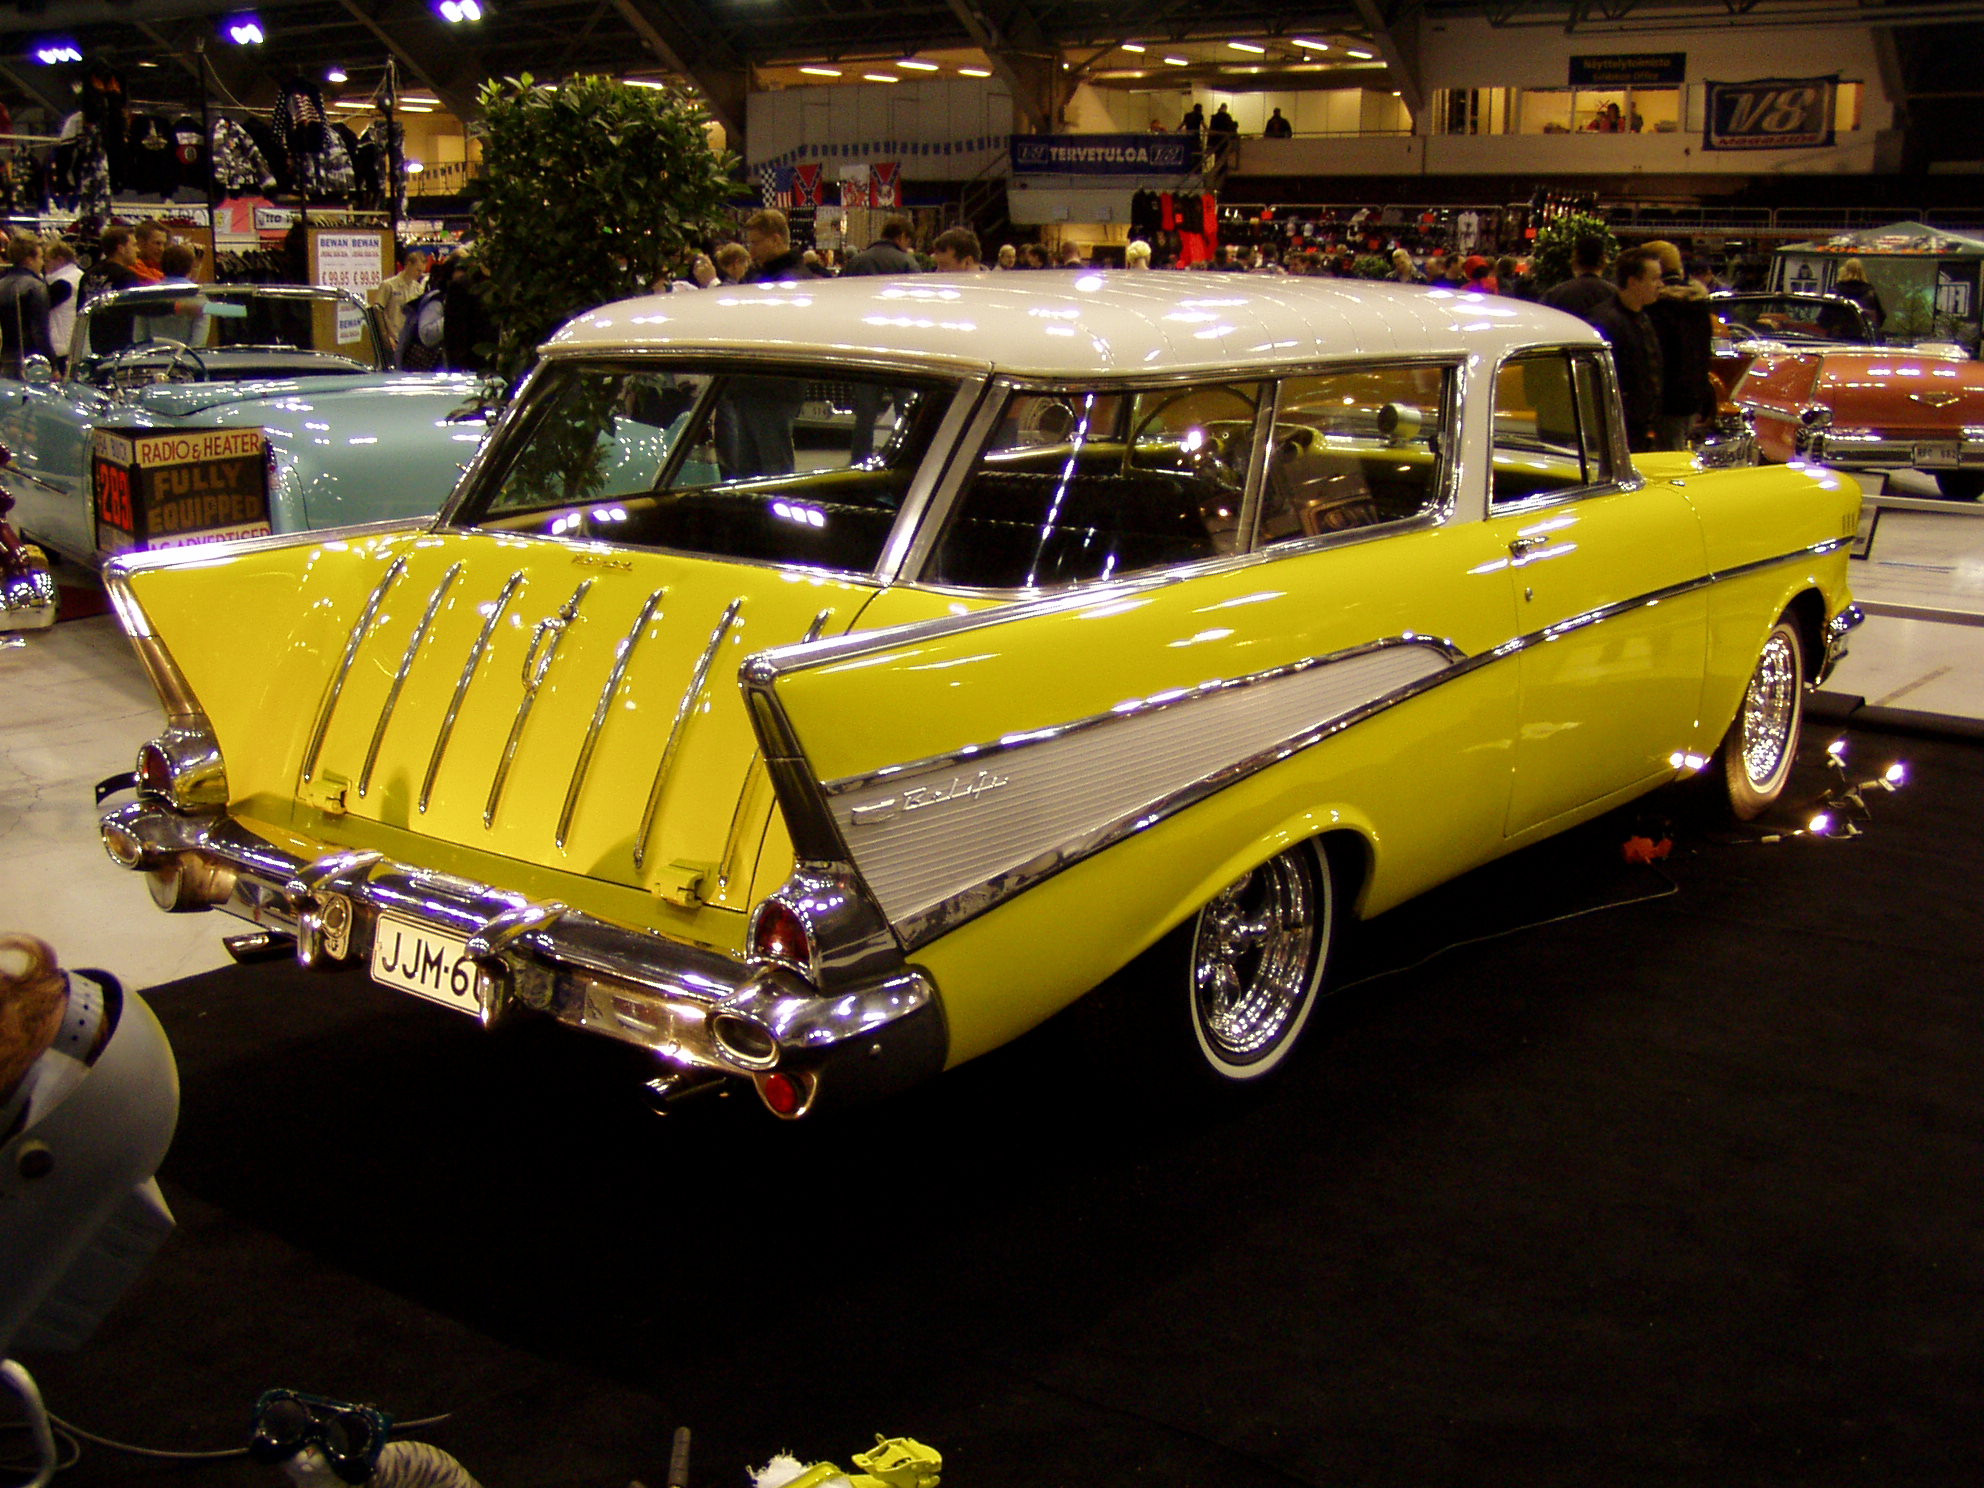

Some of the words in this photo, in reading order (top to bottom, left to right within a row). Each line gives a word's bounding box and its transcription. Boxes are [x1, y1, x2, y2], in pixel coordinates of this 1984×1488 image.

[1723, 87, 1816, 132] V8
[1050, 147, 1149, 162] TERVETULOA
[142, 440, 190, 464] RADIO
[204, 433, 260, 458] HEATER
[154, 460, 241, 500] FULLY
[148, 495, 258, 533] EQUIPPED
